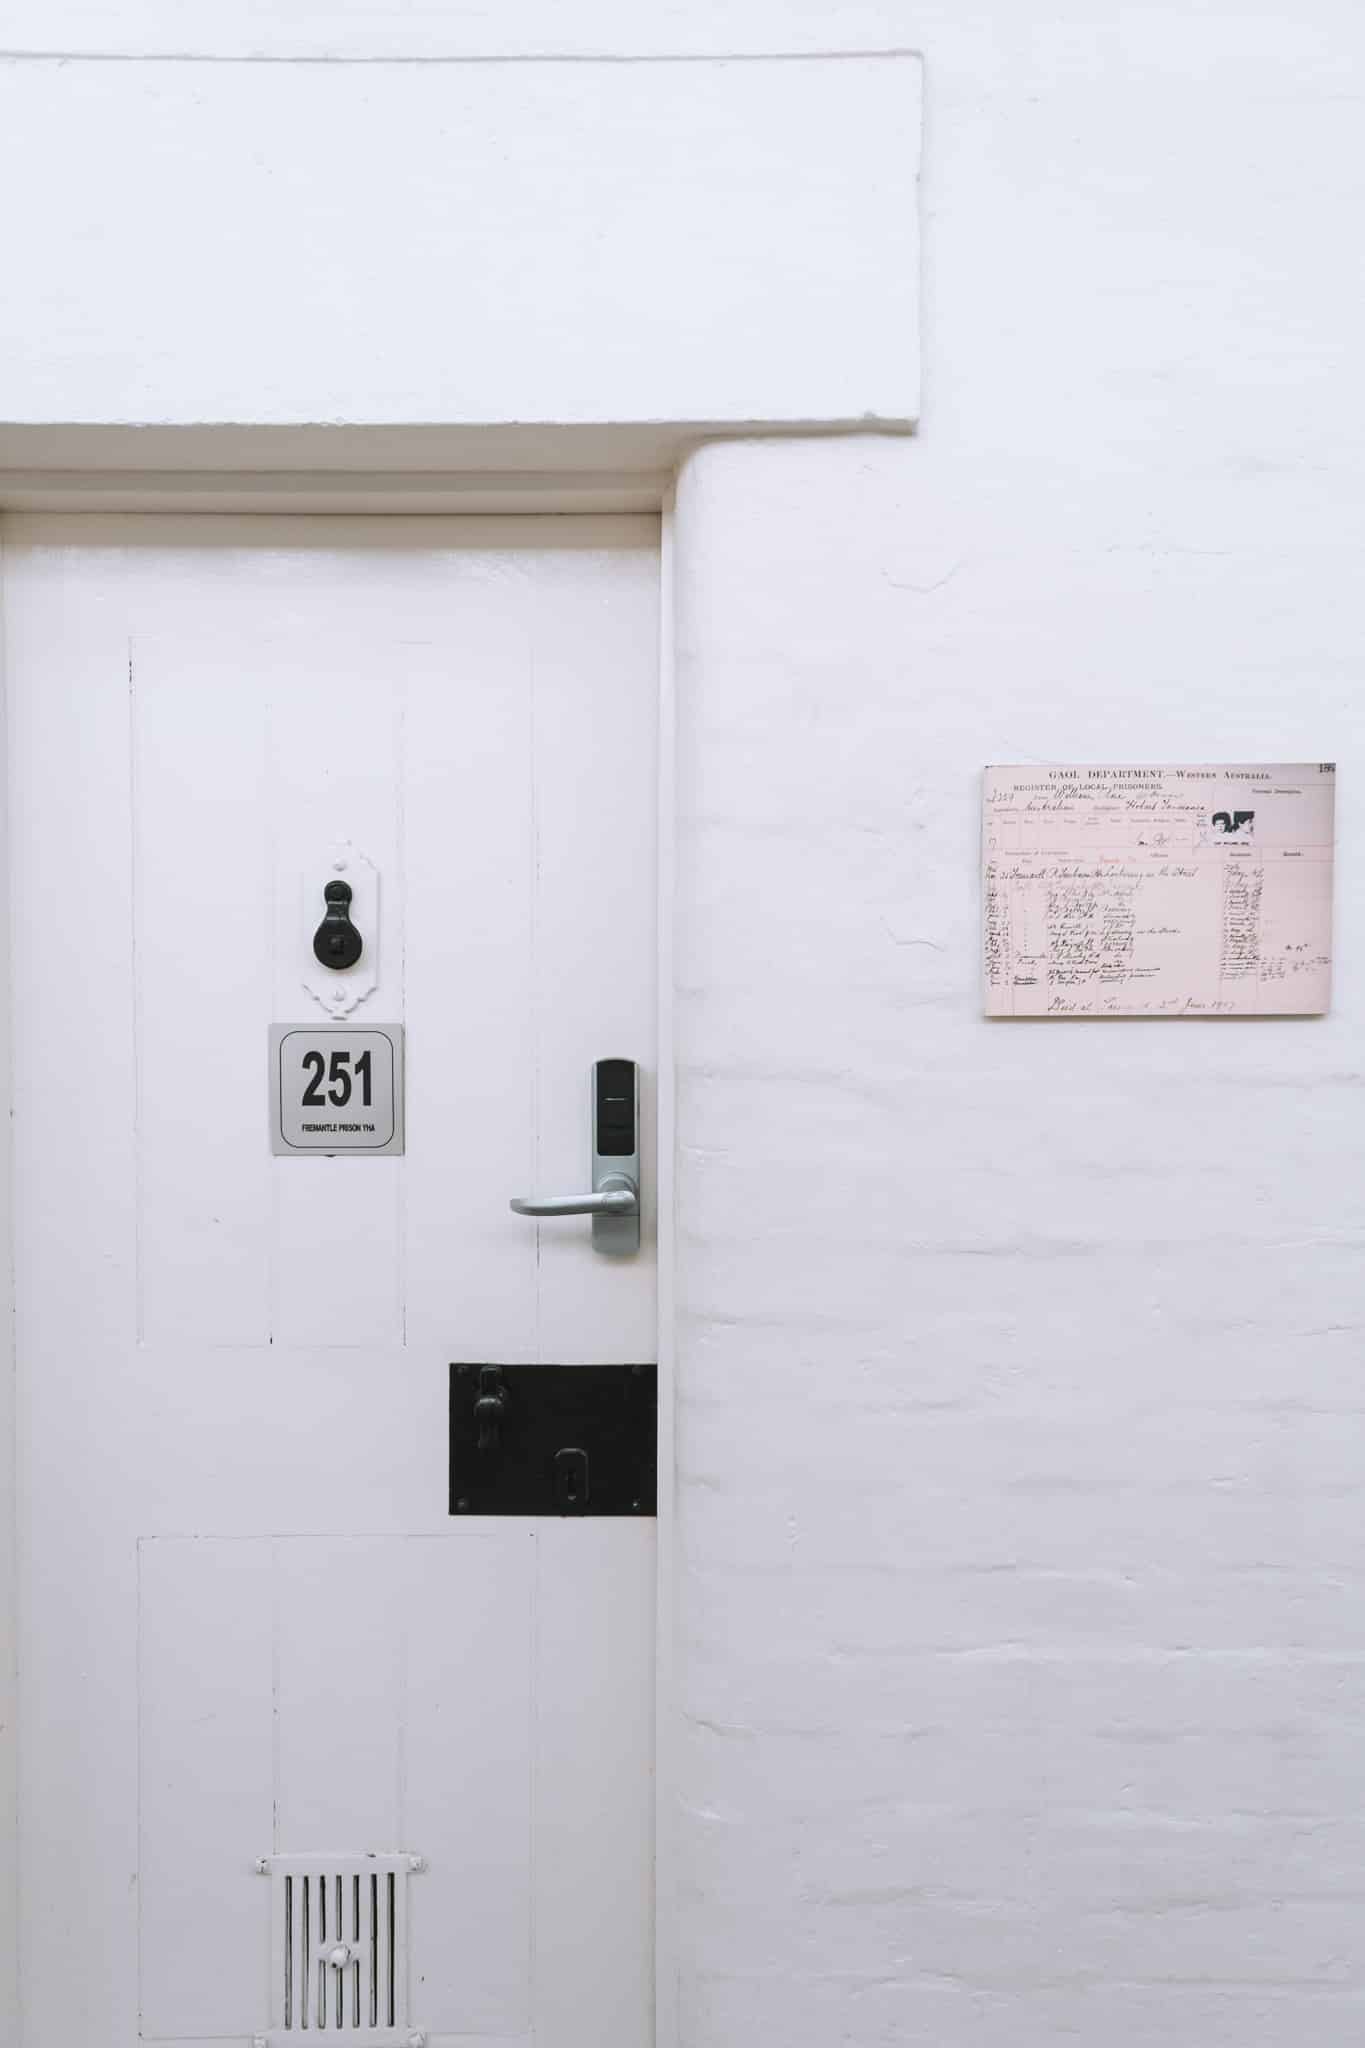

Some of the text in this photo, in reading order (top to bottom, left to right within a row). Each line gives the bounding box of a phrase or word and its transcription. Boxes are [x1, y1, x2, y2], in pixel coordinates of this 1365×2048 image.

[1048, 770, 1080, 779] GAOL
[1013, 783, 1057, 792] REGISTER
[1079, 783, 1108, 791] LOCAL
[302, 1050, 372, 1107] 251
[302, 1123, 376, 1133] FREMANTLE PRISON YHA
